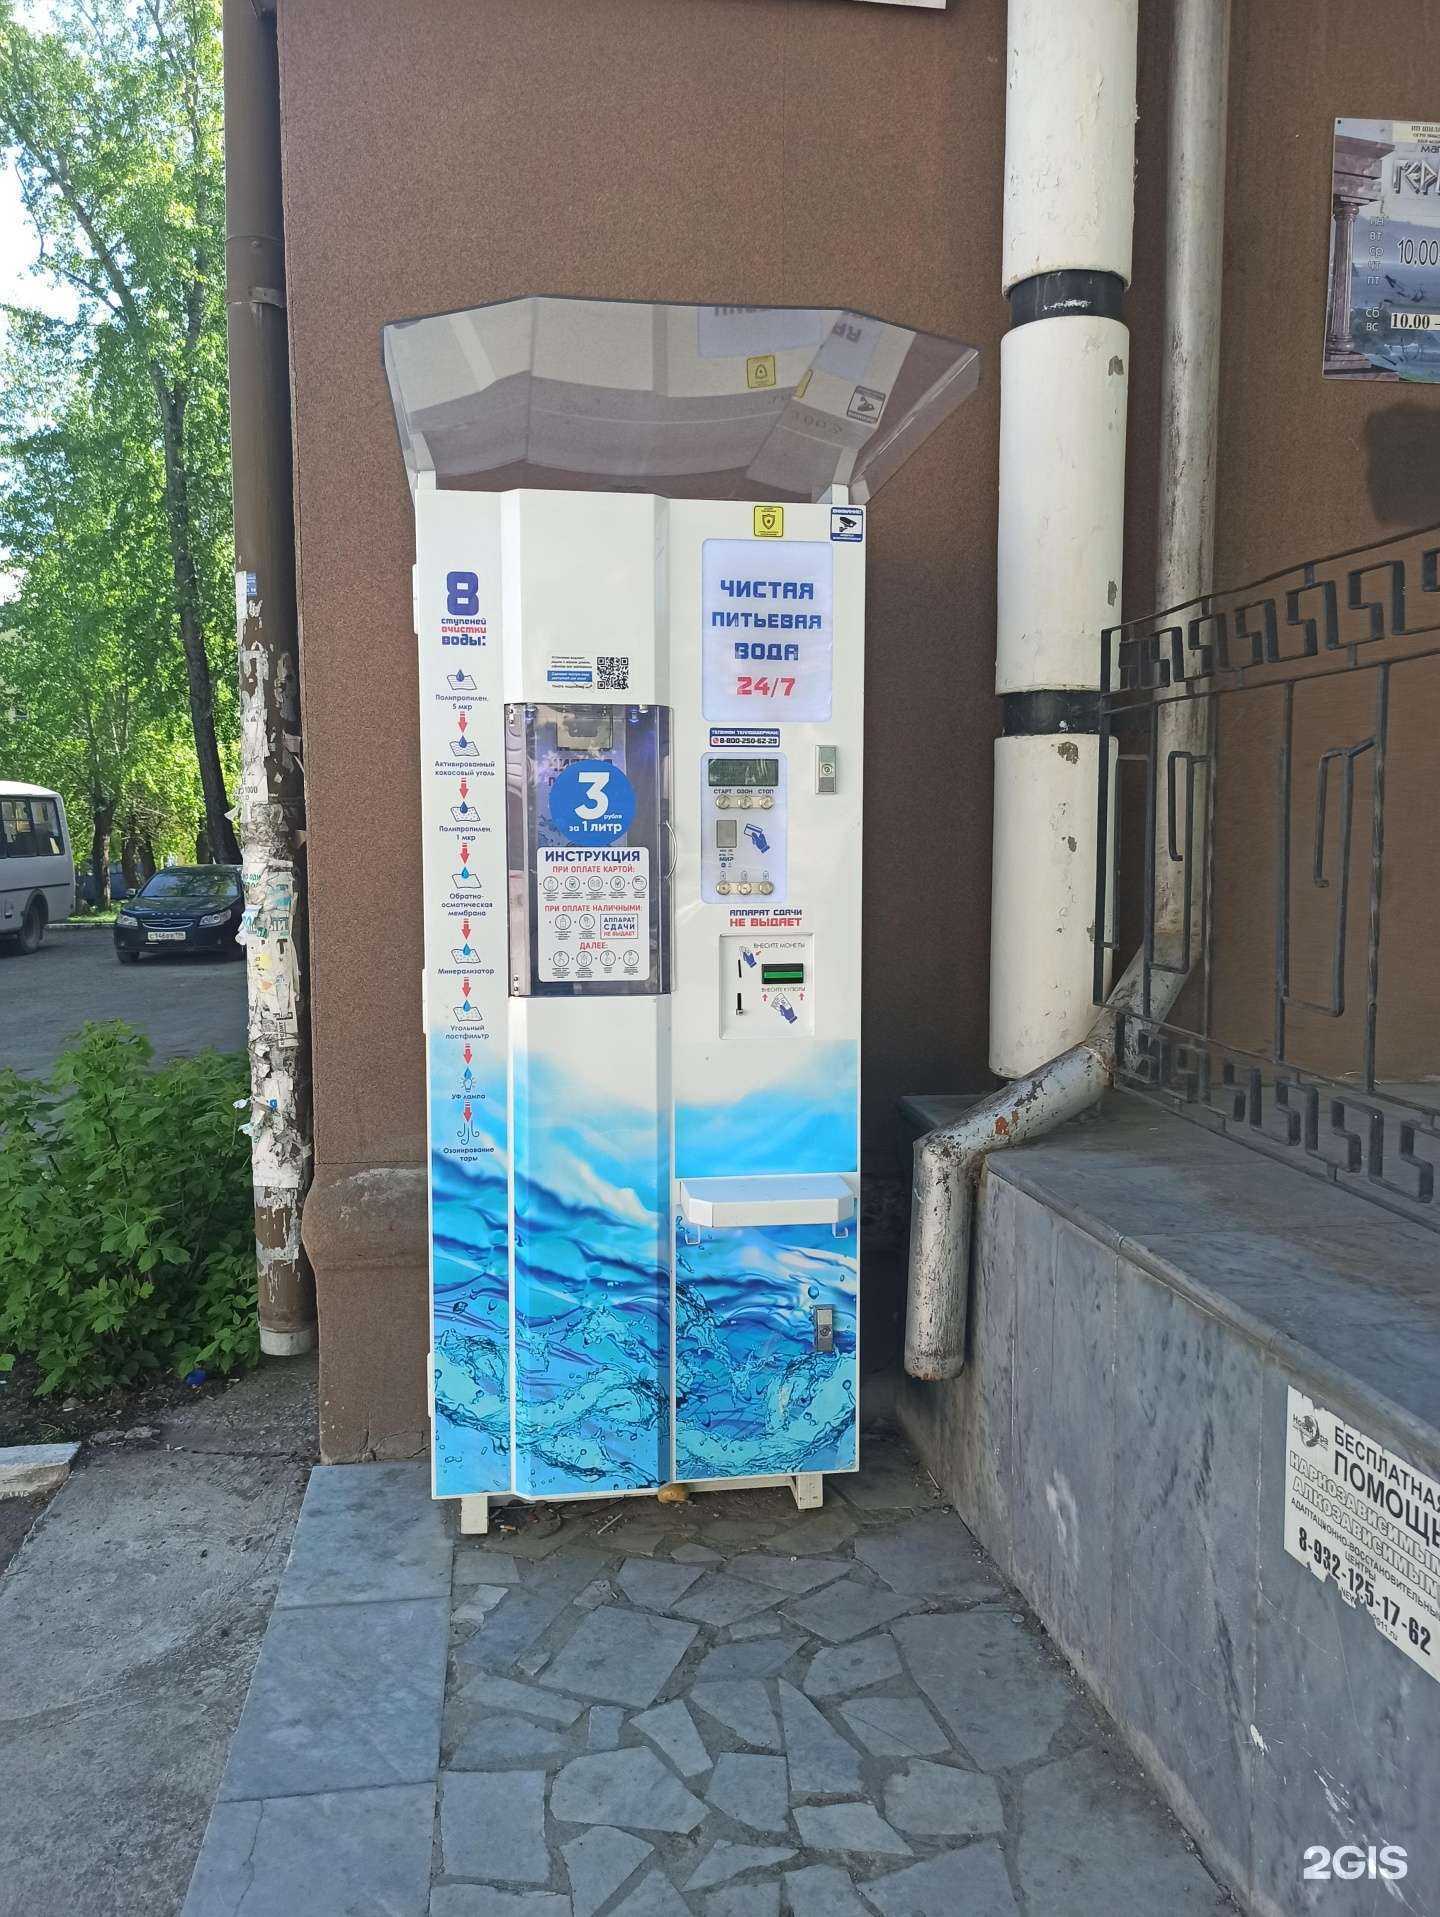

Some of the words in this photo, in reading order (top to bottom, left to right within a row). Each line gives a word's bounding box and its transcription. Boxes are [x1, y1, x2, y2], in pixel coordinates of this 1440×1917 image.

[1392, 313, 1430, 330] 10.00
[446, 571, 479, 616] 8
[720, 580, 814, 600] ЧИСТАЯ
[441, 617, 487, 626] ступеней
[711, 611, 822, 629] ПИТЬЕВАЯ
[441, 625, 487, 633] очистки
[441, 634, 487, 646] воды:
[734, 642, 799, 661] ВОДА
[736, 676, 795, 698] 24/7
[434, 760, 496, 768] Активированный
[574, 771, 610, 820] 3
[568, 824, 580, 832] за
[581, 820, 588, 832] 1
[590, 821, 623, 834] литр
[544, 850, 641, 863] ИНСТРУКЦИЯ
[552, 865, 569, 873] ПРИ
[570, 865, 601, 873] ОПЛАТЕ
[449, 892, 484, 900] Обратно-
[447, 908, 487, 917] мембрана
[544, 904, 560, 912] ПРИ
[562, 904, 591, 912] ОПЛАТЕ
[603, 923, 635, 931] СДАЧИ
[729, 918, 746, 927] НЕ
[750, 918, 802, 927] ВЫДАЕТ
[437, 968, 495, 976] Минерализатор
[443, 1147, 495, 1155] Озонирование
[1299, 1526, 1432, 1657] 8-932-125-17-62
